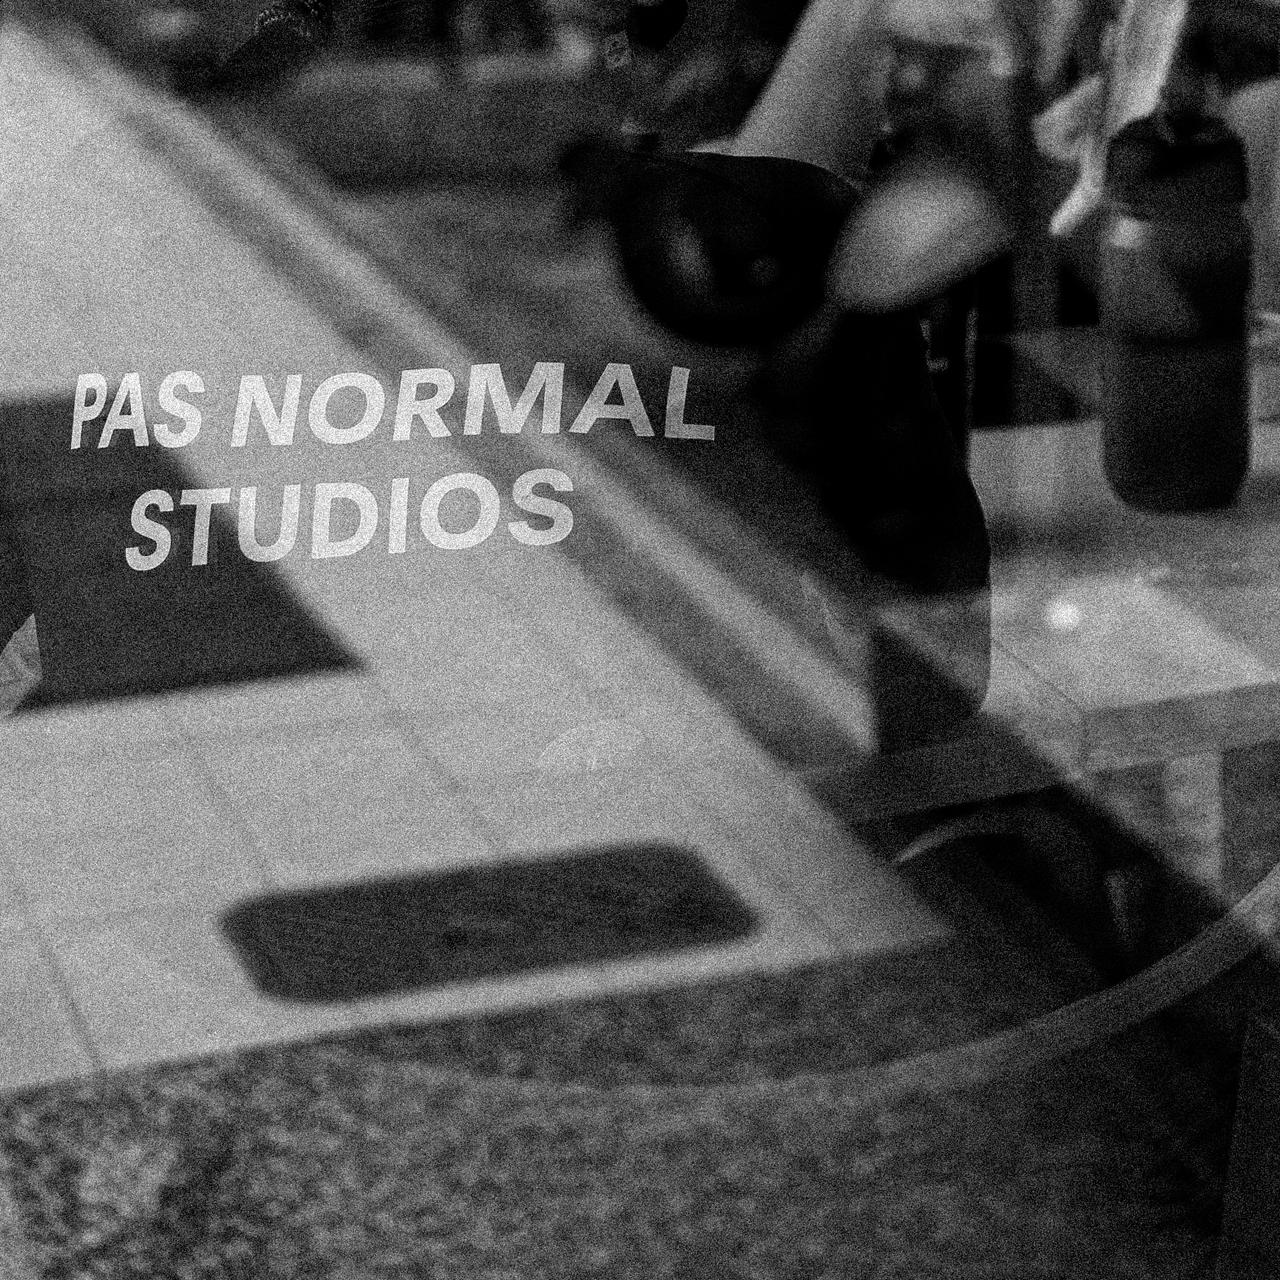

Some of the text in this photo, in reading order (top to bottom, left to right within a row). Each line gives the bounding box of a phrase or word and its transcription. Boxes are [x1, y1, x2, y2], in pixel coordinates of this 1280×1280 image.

[70, 361, 716, 450] PAS NORMAL
[125, 468, 575, 572] STUDIOS
